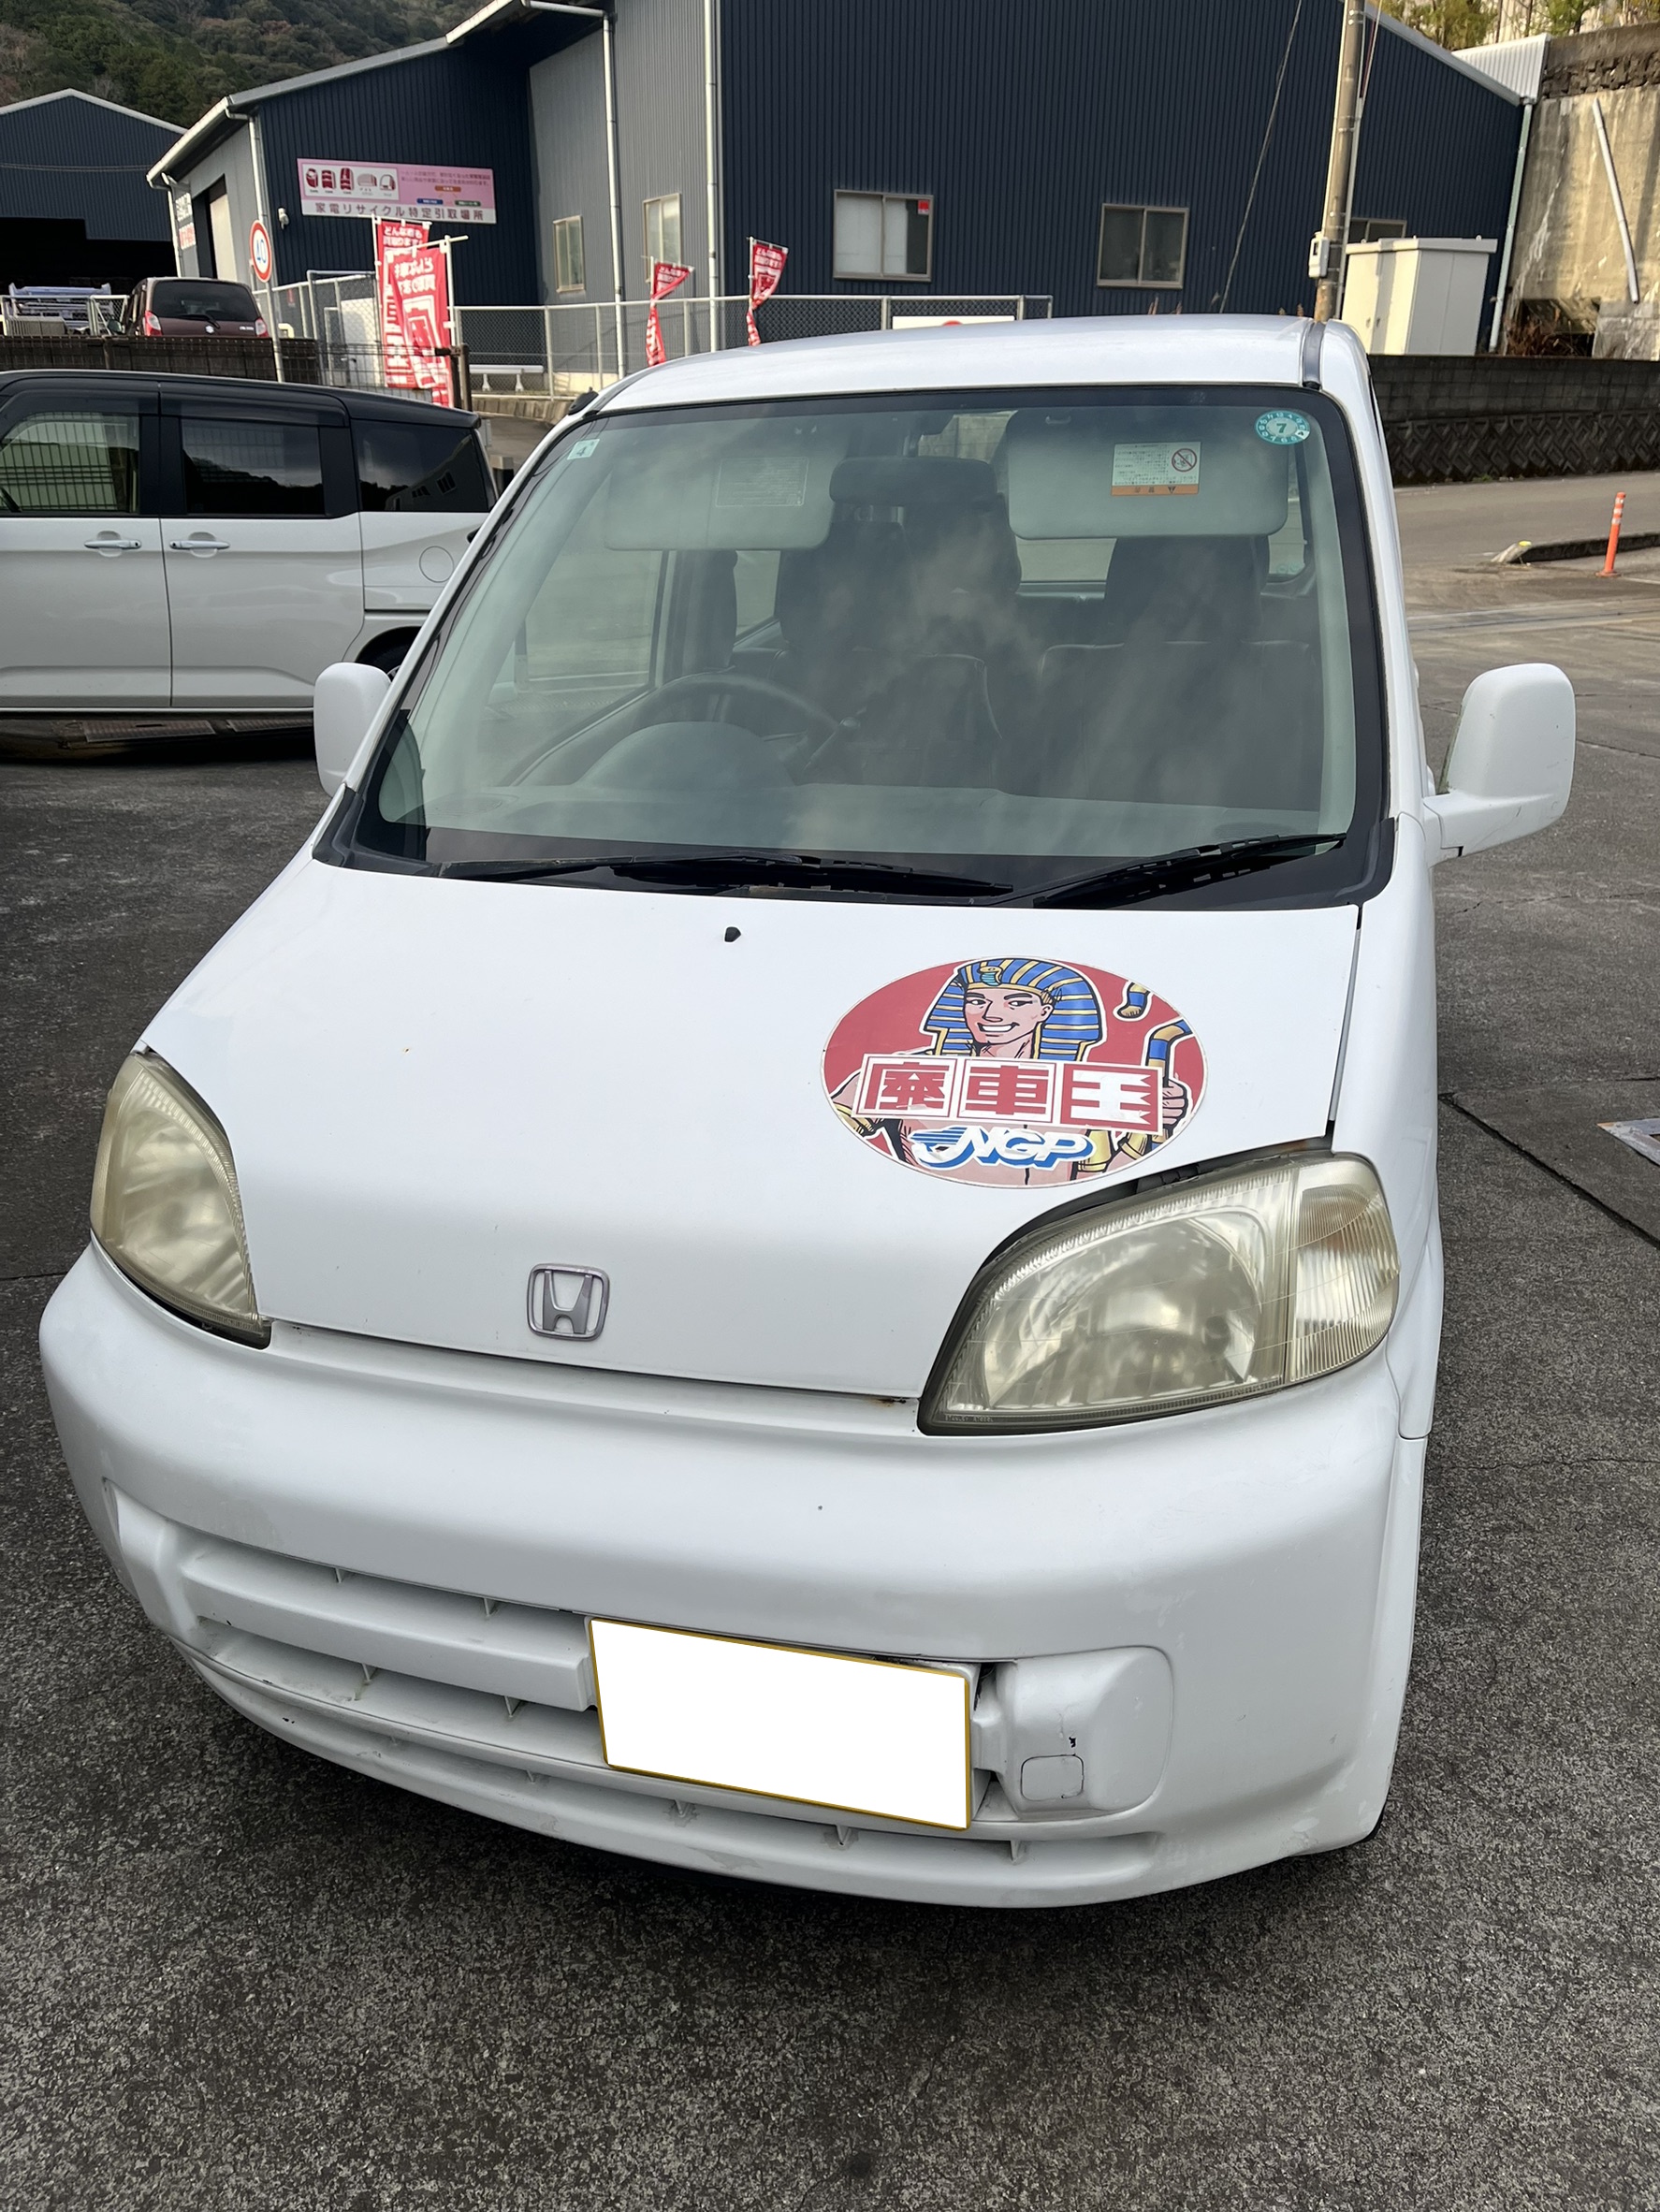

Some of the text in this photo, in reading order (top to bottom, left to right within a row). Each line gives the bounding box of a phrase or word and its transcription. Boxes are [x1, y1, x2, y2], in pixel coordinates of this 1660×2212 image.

[314, 202, 484, 221] 家電リサイクル特定引取場所
[255, 239, 268, 264] 40
[1276, 423, 1288, 434] 7
[863, 1058, 1157, 1128] 廃車王
[913, 1127, 1094, 1168] NGP
